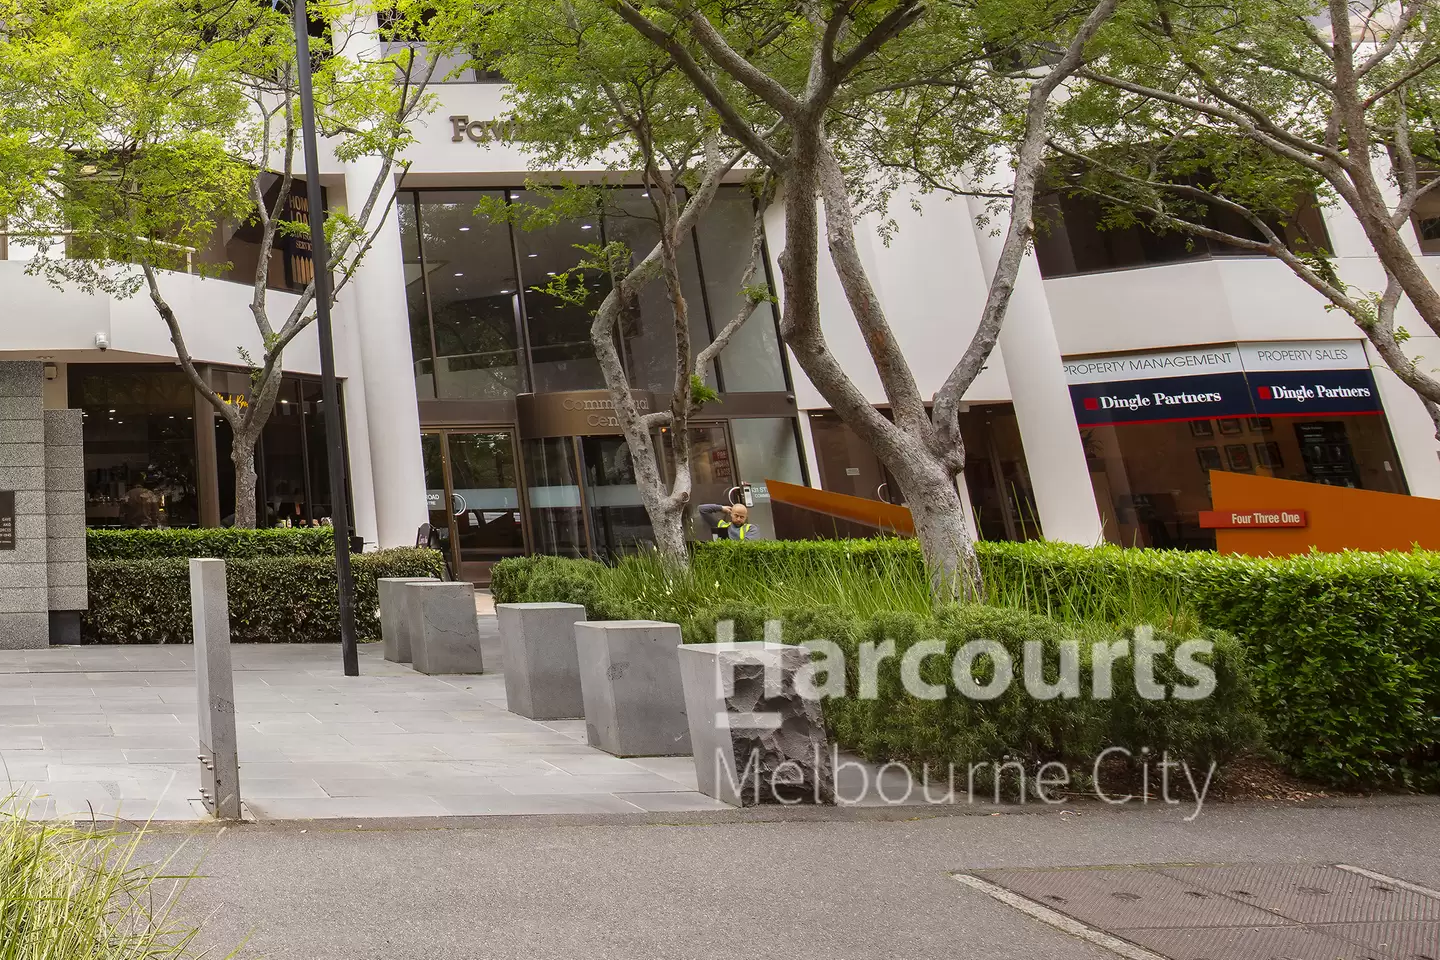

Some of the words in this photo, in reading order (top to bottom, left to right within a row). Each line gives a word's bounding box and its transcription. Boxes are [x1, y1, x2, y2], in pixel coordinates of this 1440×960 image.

[289, 195, 309, 212] HOM
[1063, 361, 1126, 376] PROPERTY
[1129, 352, 1232, 371] MANAGEMENT
[1258, 350, 1313, 362] PROPERTY
[1316, 349, 1348, 361] SALES
[1099, 394, 1151, 411] Dingle
[1153, 391, 1222, 406] Partners
[1271, 385, 1315, 402] Dingle
[1315, 385, 1371, 398] Partners
[587, 414, 620, 427] Cen
[1231, 513, 1252, 524] Four
[1253, 512, 1280, 524] Three
[1281, 511, 1301, 523] One
